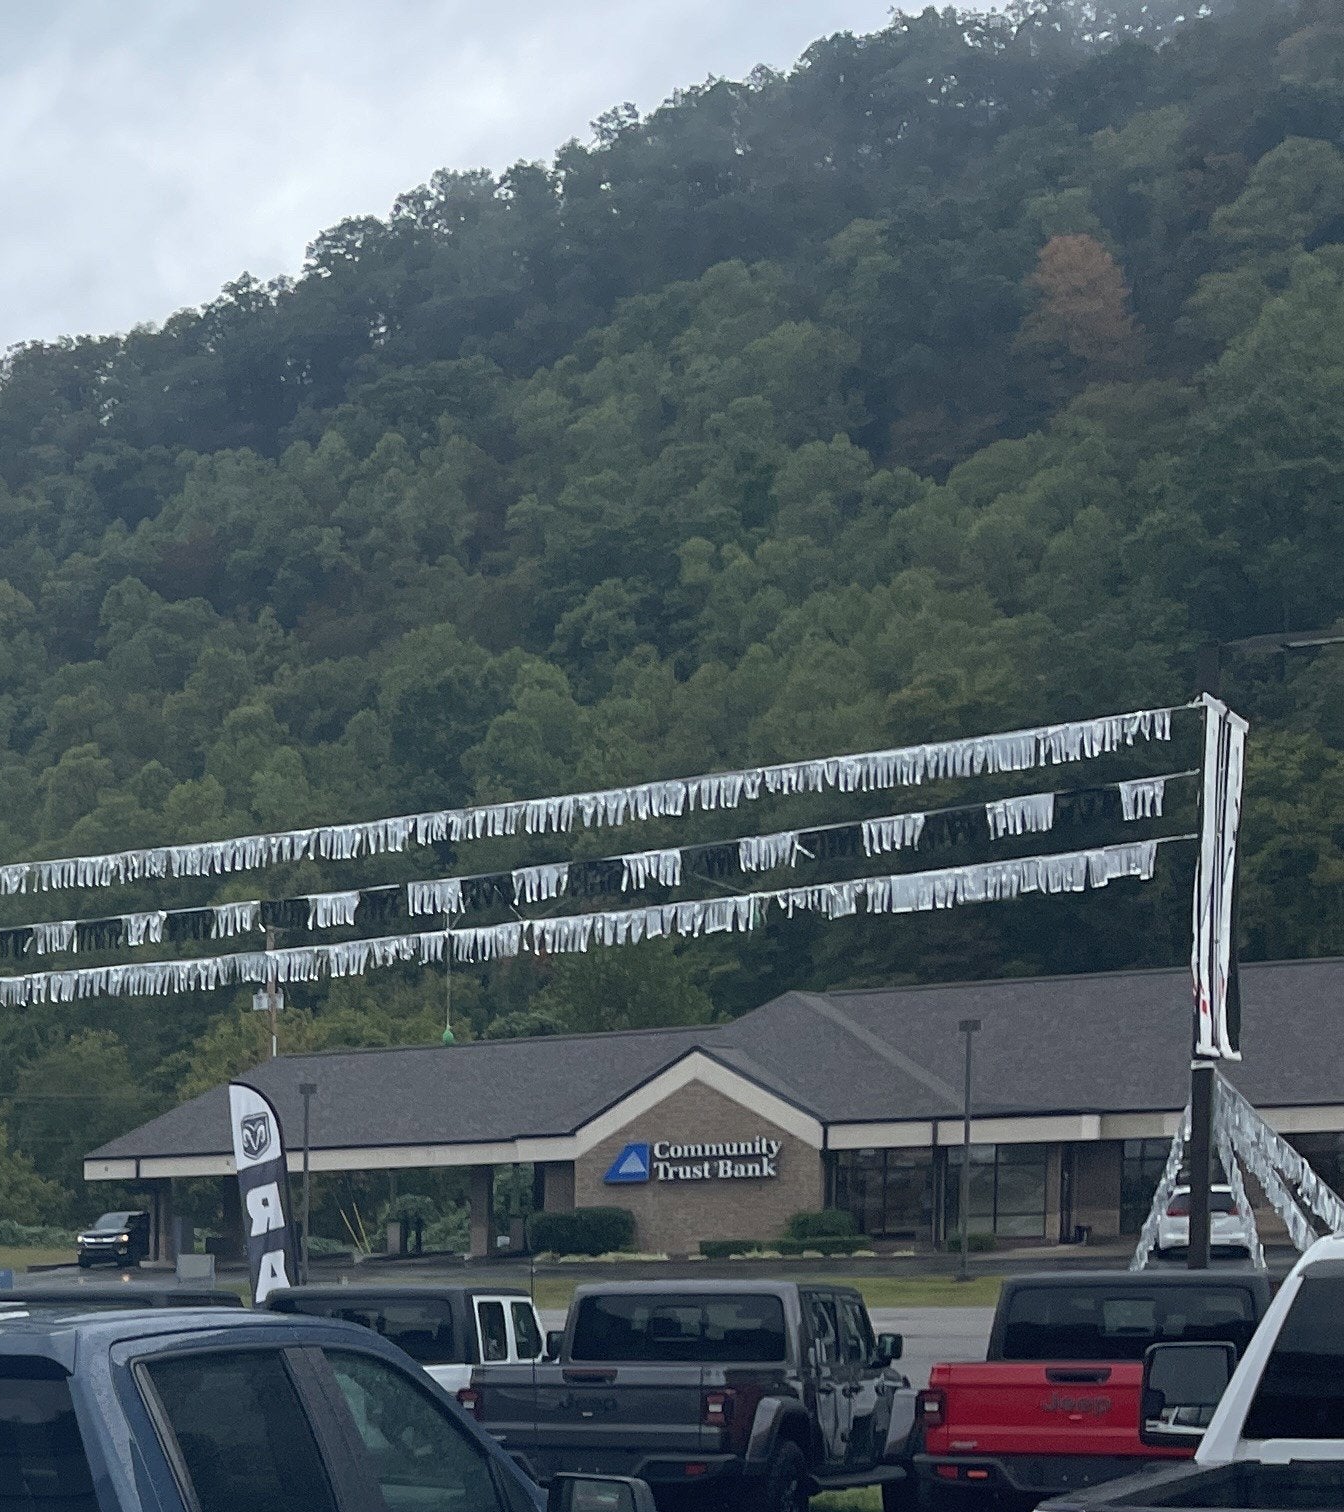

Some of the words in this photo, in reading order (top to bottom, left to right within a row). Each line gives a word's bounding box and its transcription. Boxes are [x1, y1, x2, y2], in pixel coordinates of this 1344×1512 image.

[653, 1136, 782, 1160] Community
[654, 1161, 711, 1180] Trust
[718, 1157, 777, 1178] Bank
